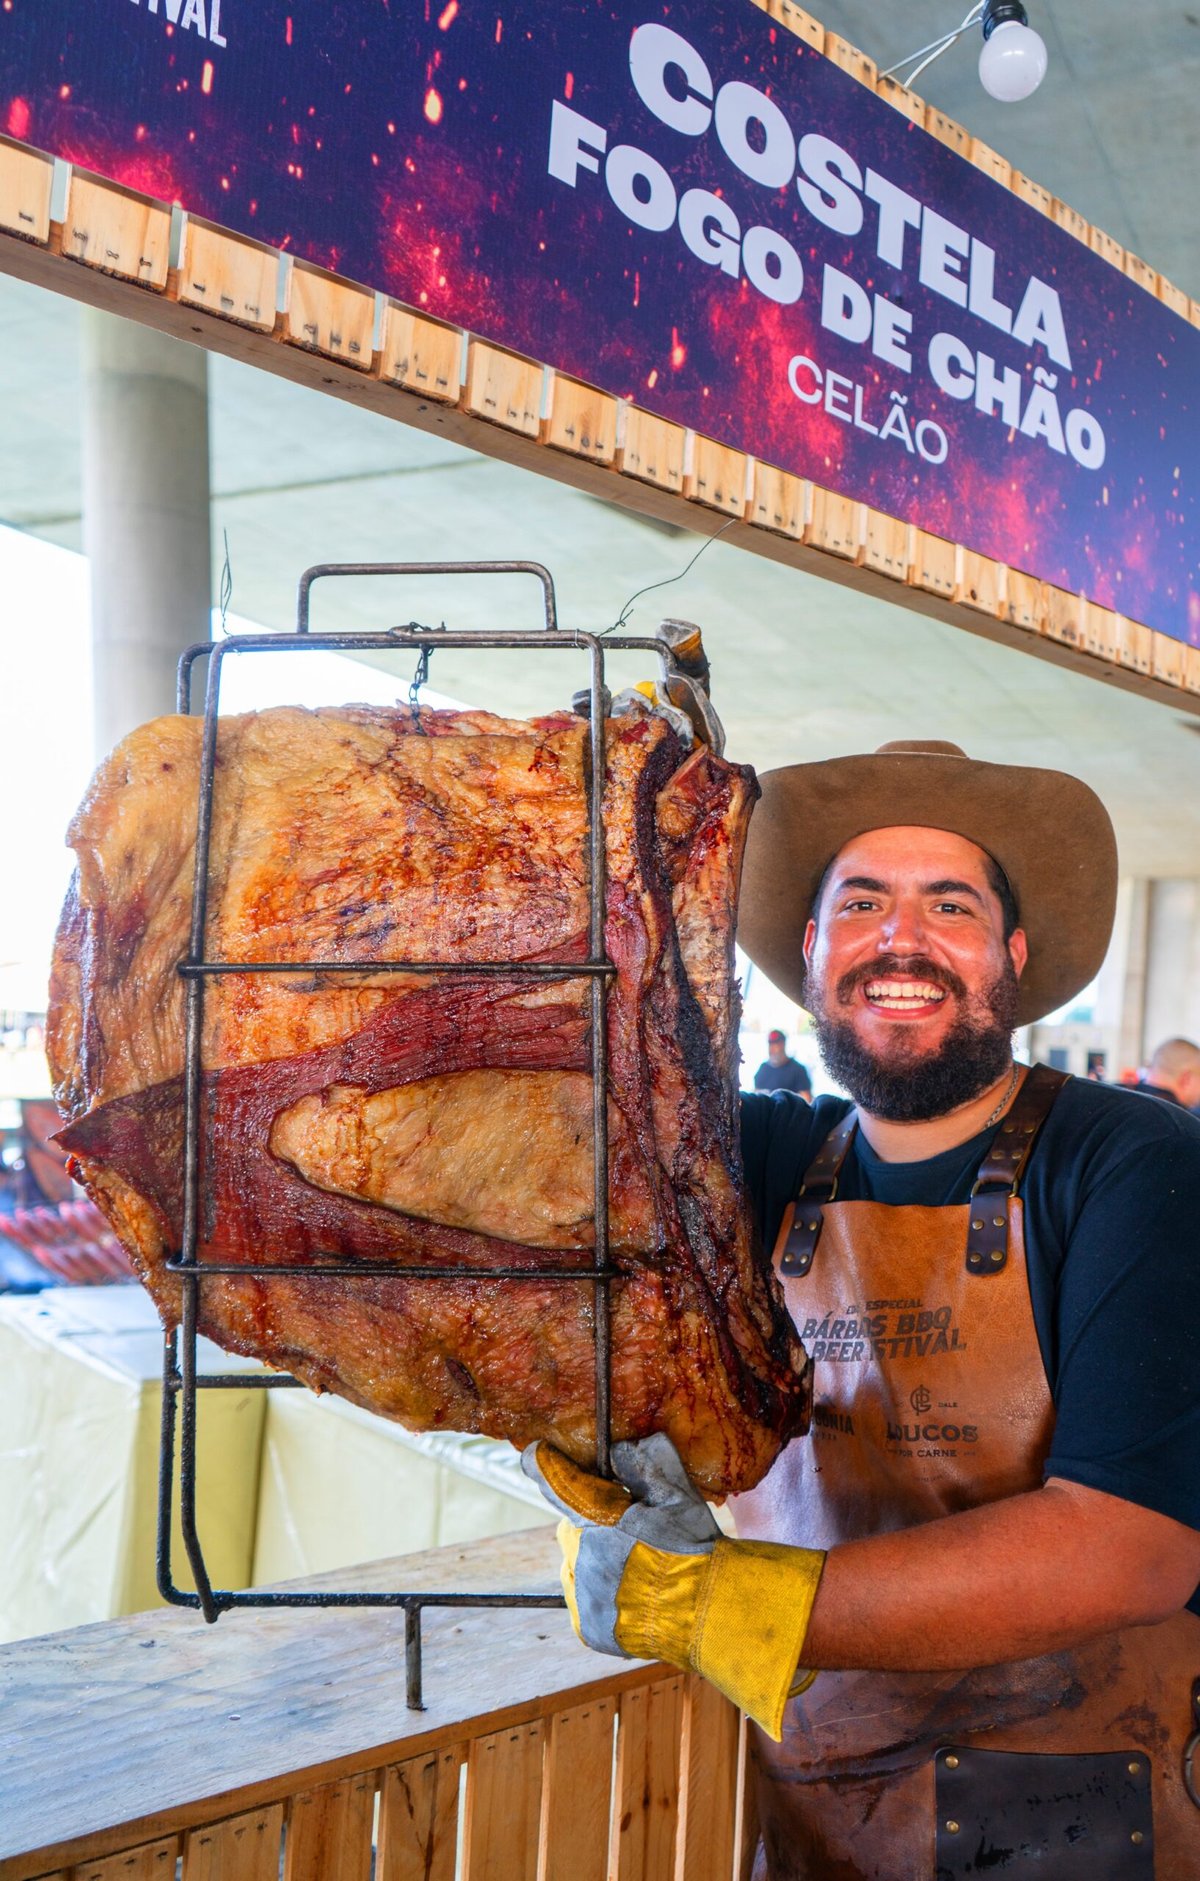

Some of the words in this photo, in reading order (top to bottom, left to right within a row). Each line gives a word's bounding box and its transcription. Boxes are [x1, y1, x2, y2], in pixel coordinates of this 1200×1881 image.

[630, 23, 1073, 370] COSTELA
[548, 100, 804, 304] FOGO
[821, 264, 913, 373] DE
[928, 332, 1106, 470] CHÃO
[788, 356, 949, 465] CELÃO
[866, 1299, 924, 1311] ESPECIAL
[896, 1306, 953, 1335] BBQ
[811, 1341, 866, 1363] BEER
[917, 1449, 957, 1458] CARNE
